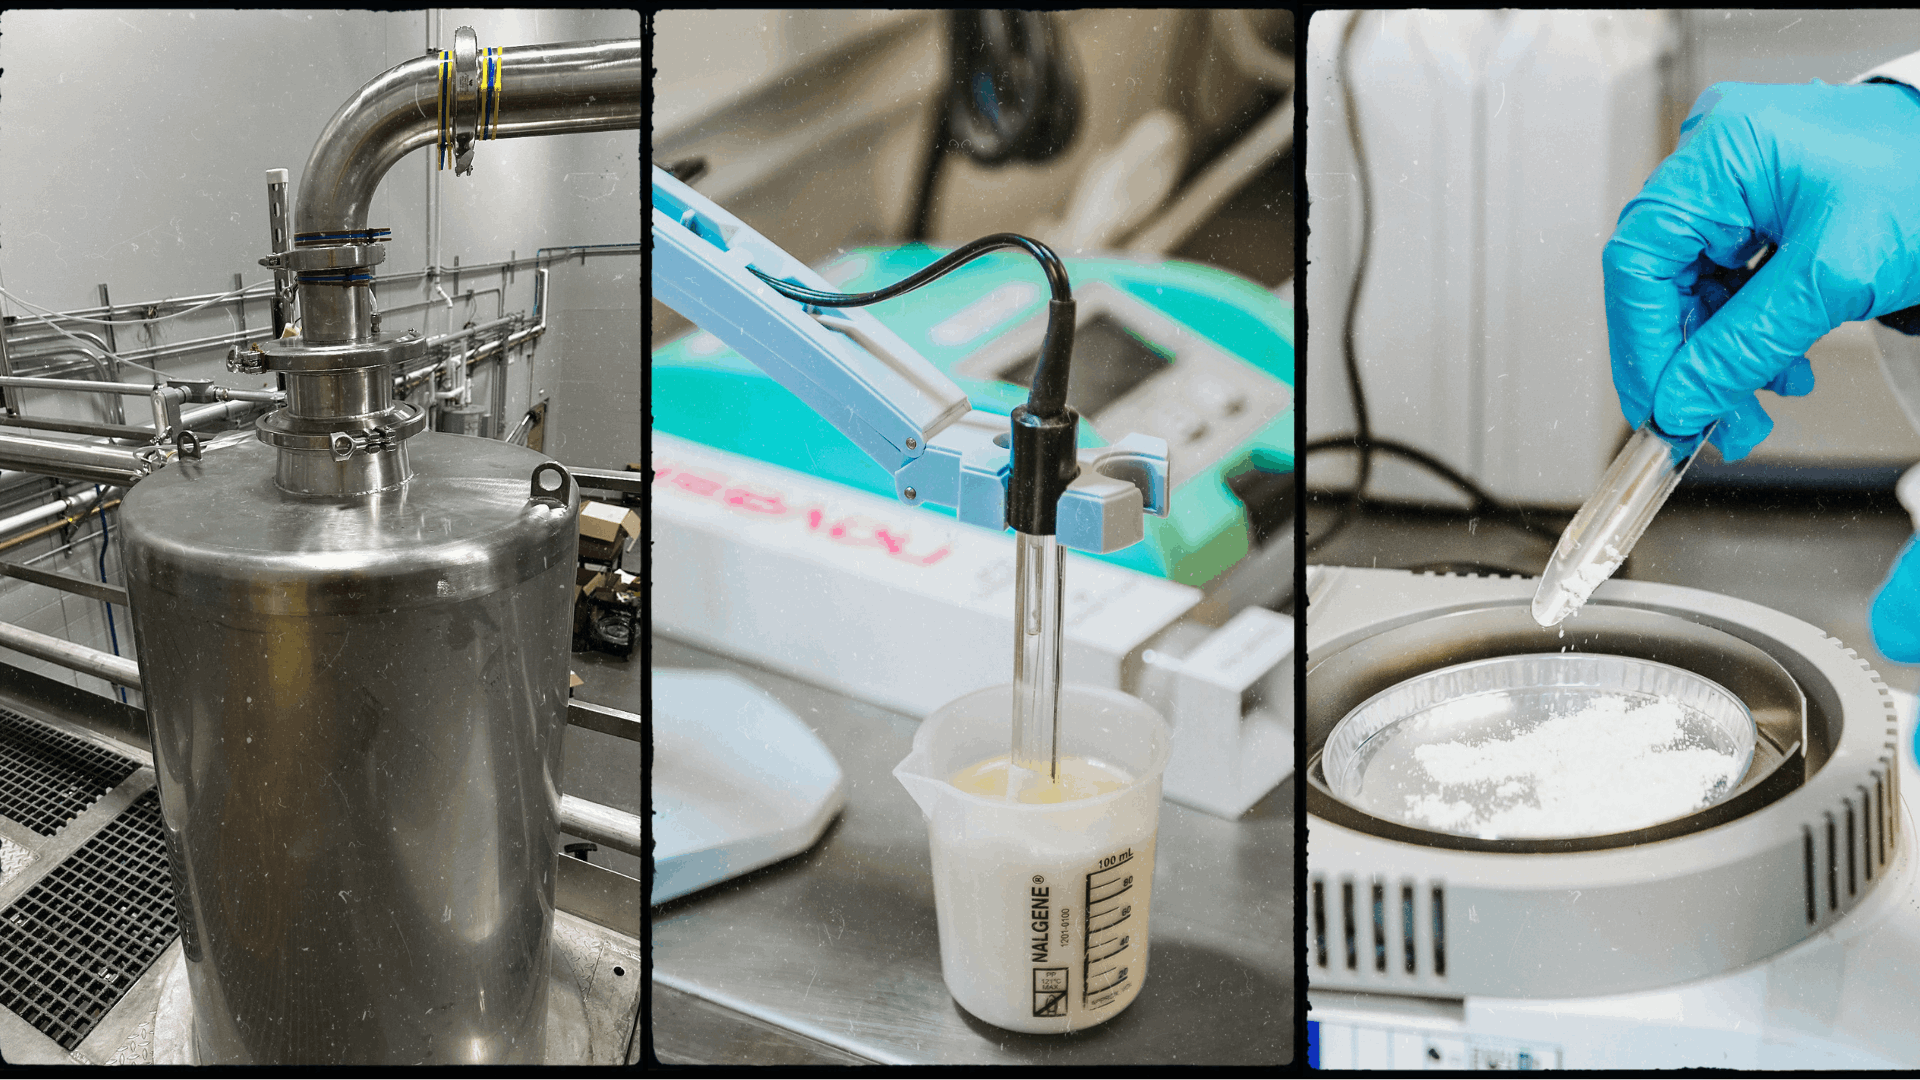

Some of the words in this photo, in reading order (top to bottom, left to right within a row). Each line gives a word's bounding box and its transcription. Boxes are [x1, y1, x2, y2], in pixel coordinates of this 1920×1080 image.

[1099, 855, 1116, 869] 100
[1119, 848, 1134, 861] mL
[1123, 875, 1134, 887] 80
[1121, 905, 1131, 916] 60
[1060, 908, 1070, 947] 1201-0100
[1119, 935, 1129, 946] 40
[1118, 967, 1129, 979] 20
